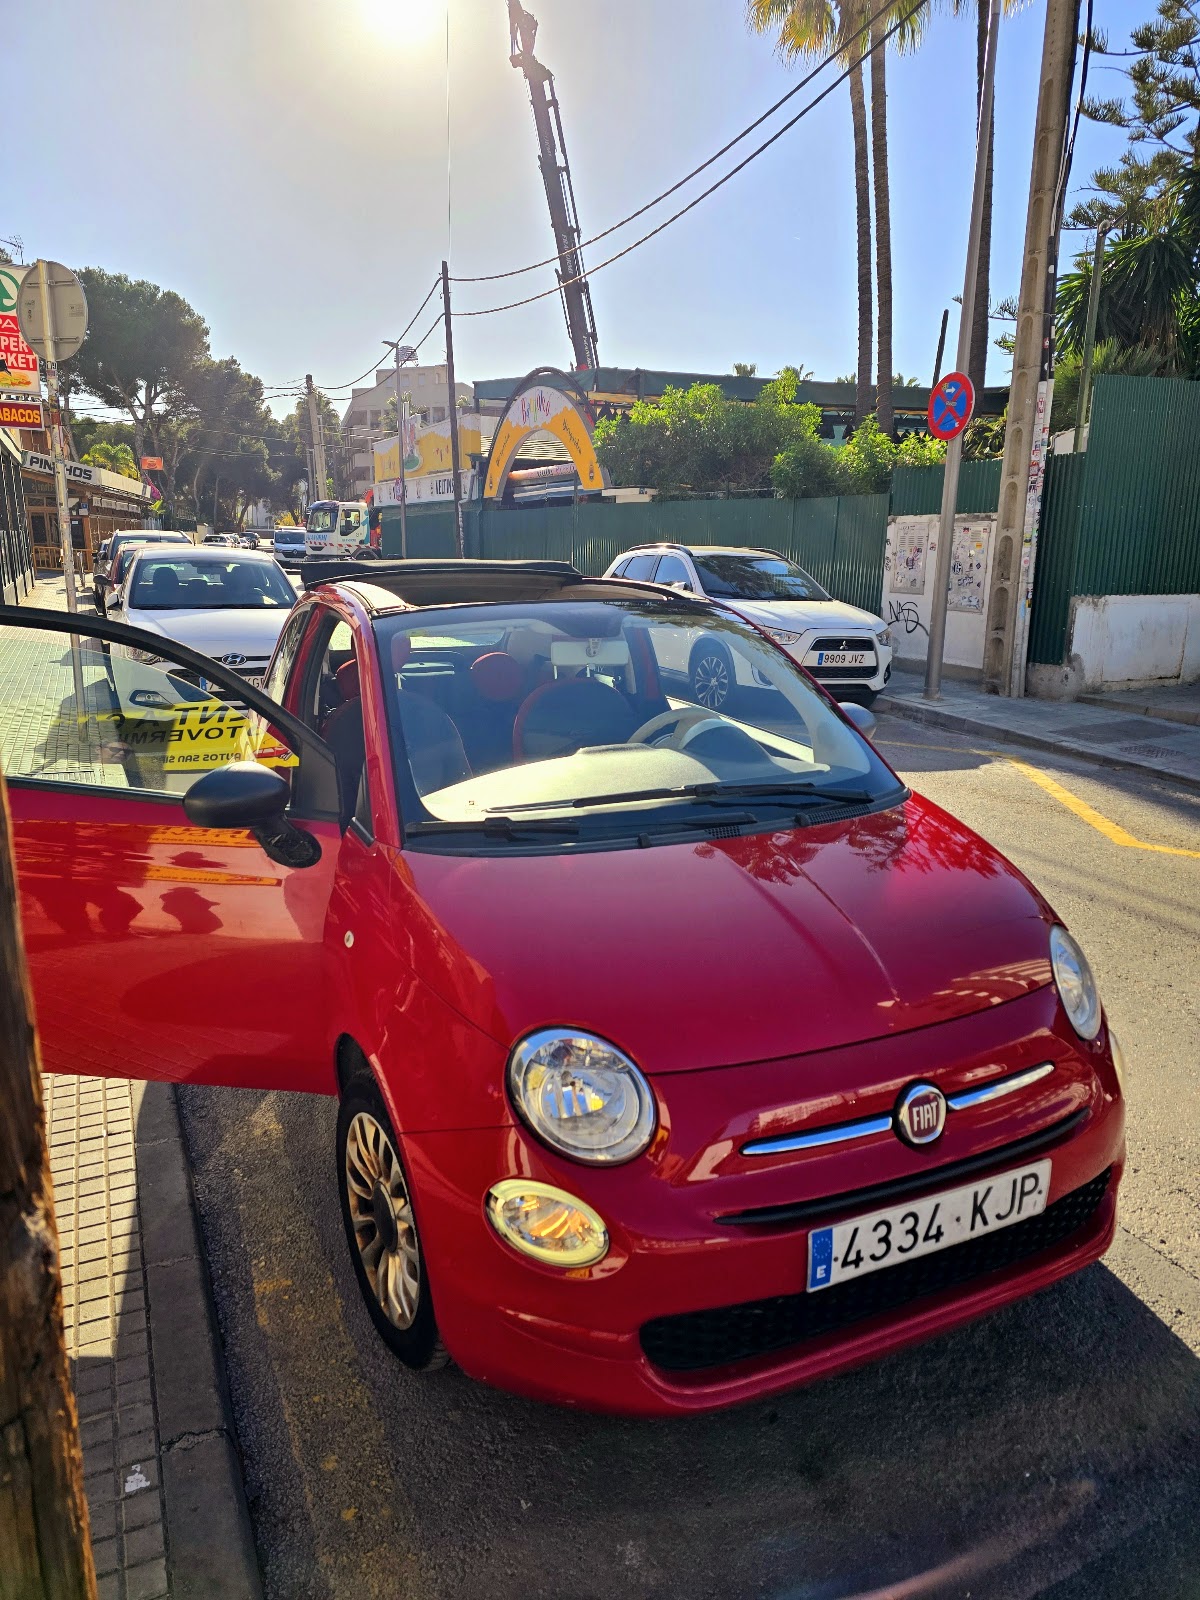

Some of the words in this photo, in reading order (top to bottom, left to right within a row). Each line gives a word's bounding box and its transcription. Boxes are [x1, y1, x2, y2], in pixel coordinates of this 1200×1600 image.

[29, 455, 93, 481] PINHOS
[824, 654, 846, 664] 9909
[848, 654, 865, 664] JVZ
[912, 1101, 938, 1132] FIAT
[816, 1265, 826, 1279] E
[841, 1203, 944, 1270] 4334
[969, 1172, 1040, 1232] KJP
